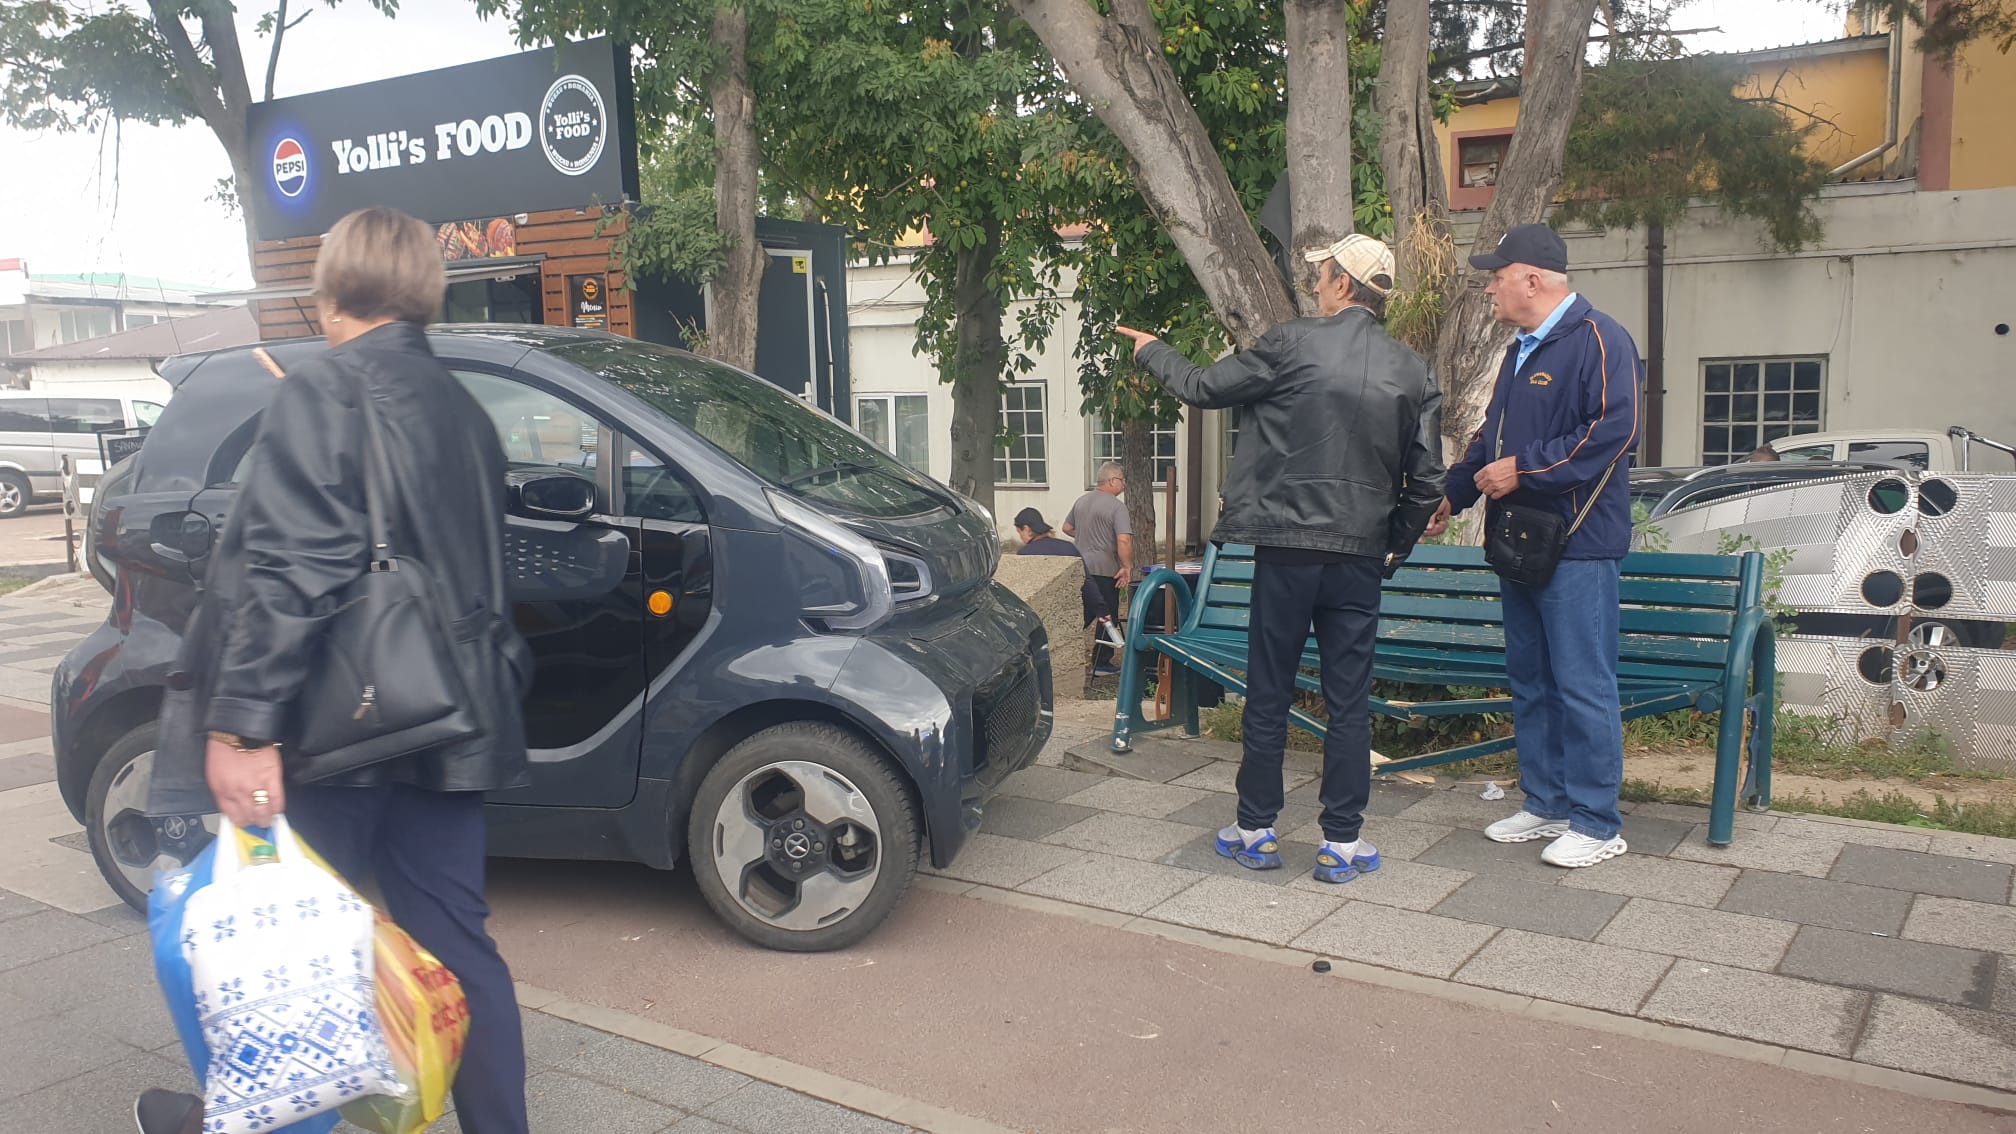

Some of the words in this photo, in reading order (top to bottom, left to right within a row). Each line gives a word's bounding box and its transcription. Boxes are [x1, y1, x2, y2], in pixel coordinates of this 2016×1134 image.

[553, 110, 591, 127] Yolli's
[555, 123, 591, 140] FOOD
[331, 130, 426, 174] Yolli's
[434, 111, 533, 161] FOOD
[276, 160, 305, 175] PEPSI
